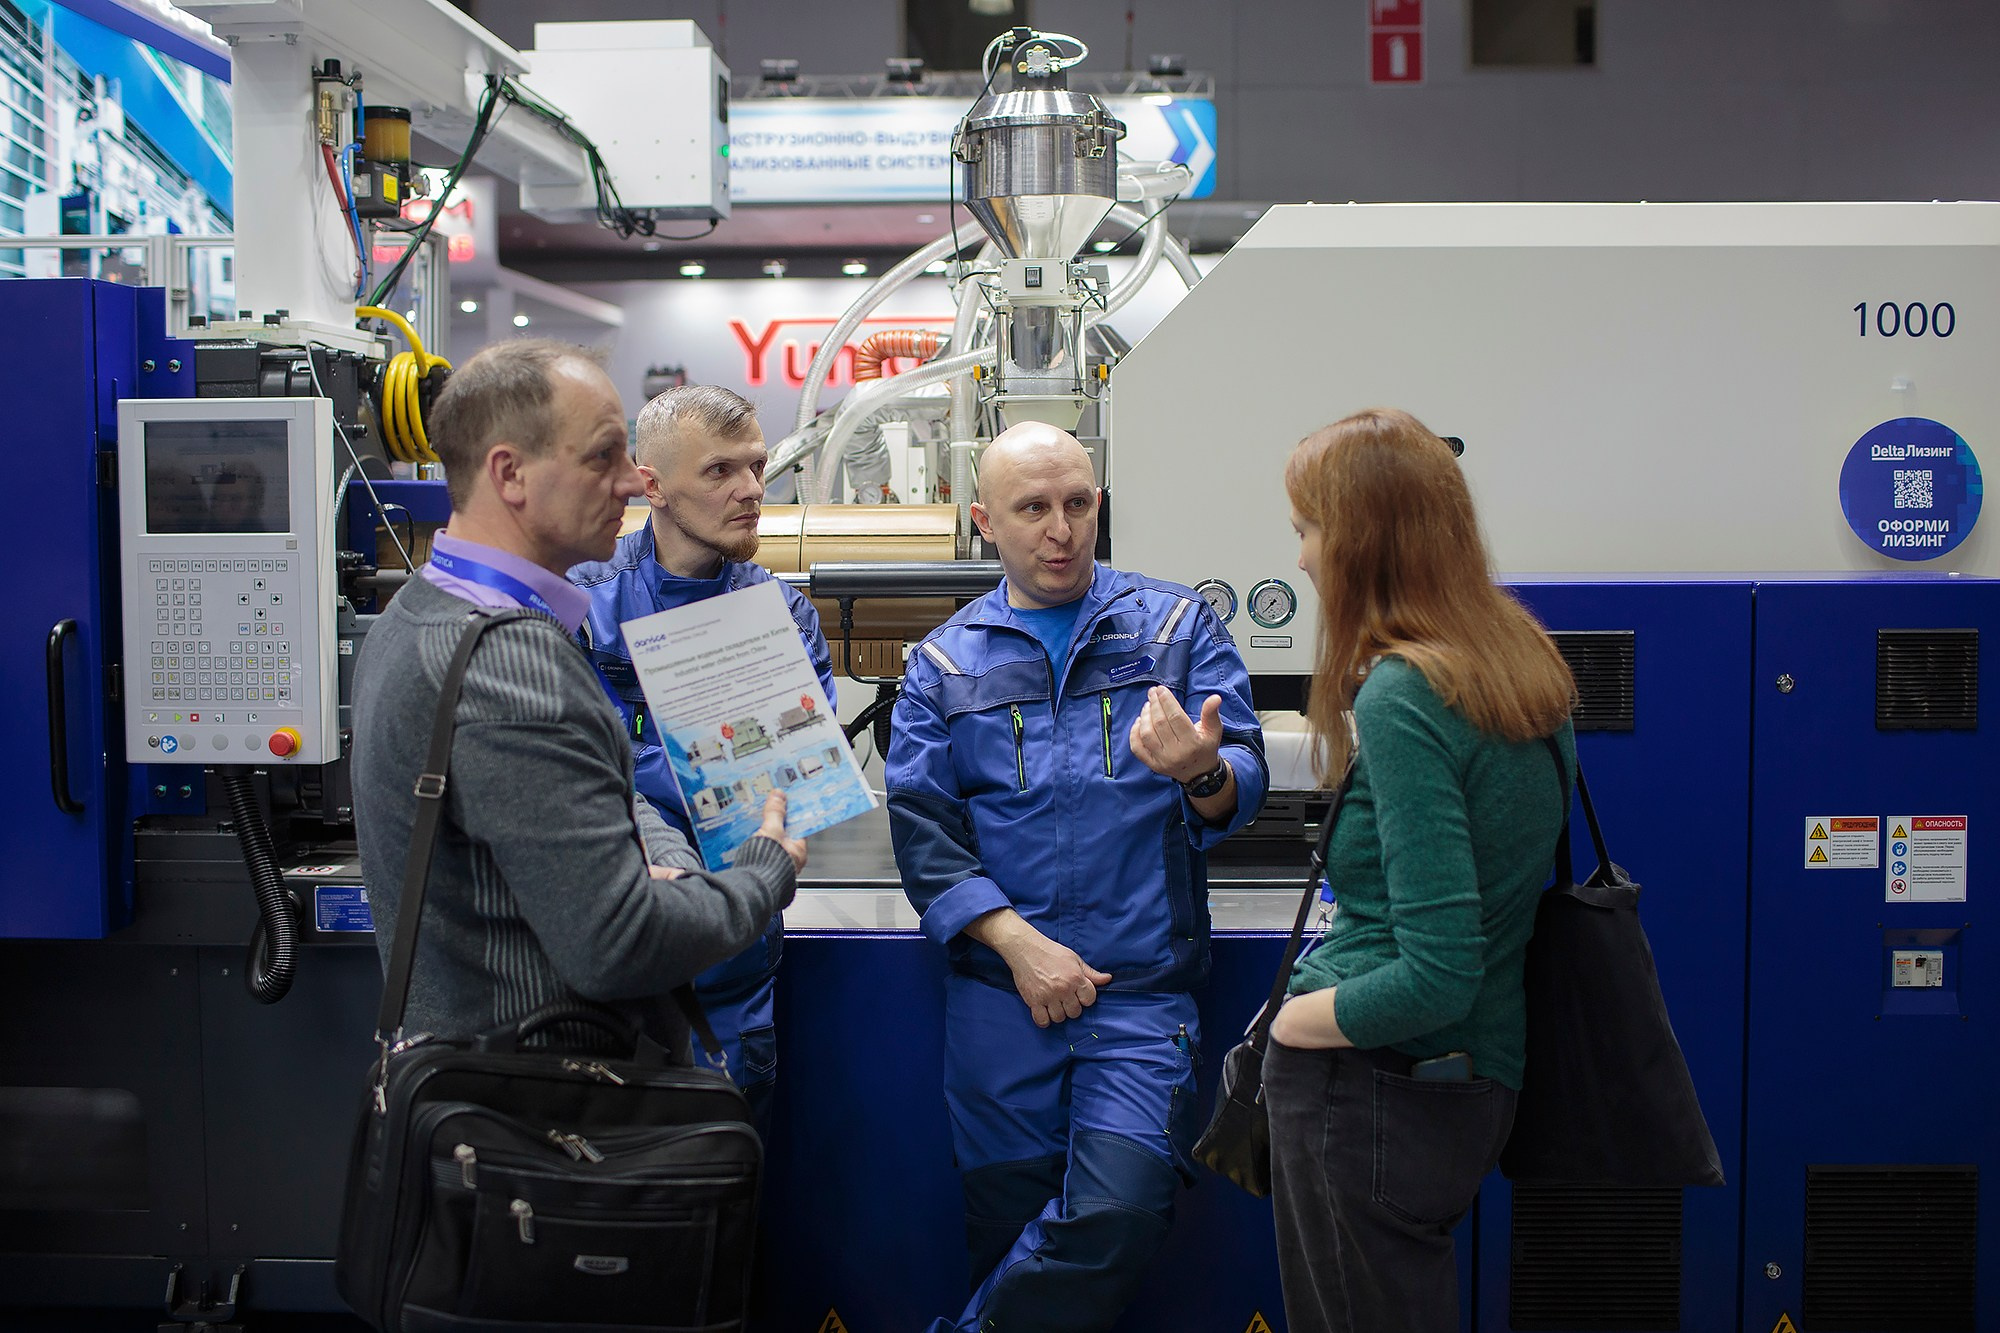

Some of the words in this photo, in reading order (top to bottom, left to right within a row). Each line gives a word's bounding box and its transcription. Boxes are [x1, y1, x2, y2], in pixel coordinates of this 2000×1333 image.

[729, 155, 870, 170] АЛИЗОВАННЫЕ
[877, 154, 955, 169] СИСТЕМ
[1853, 302, 1956, 338] 1000
[1878, 519, 1949, 532] ОФОРМИ
[1882, 534, 1946, 547] ЛИЗИНГ
[1925, 820, 1963, 828] ОПАСНОСТЬ
